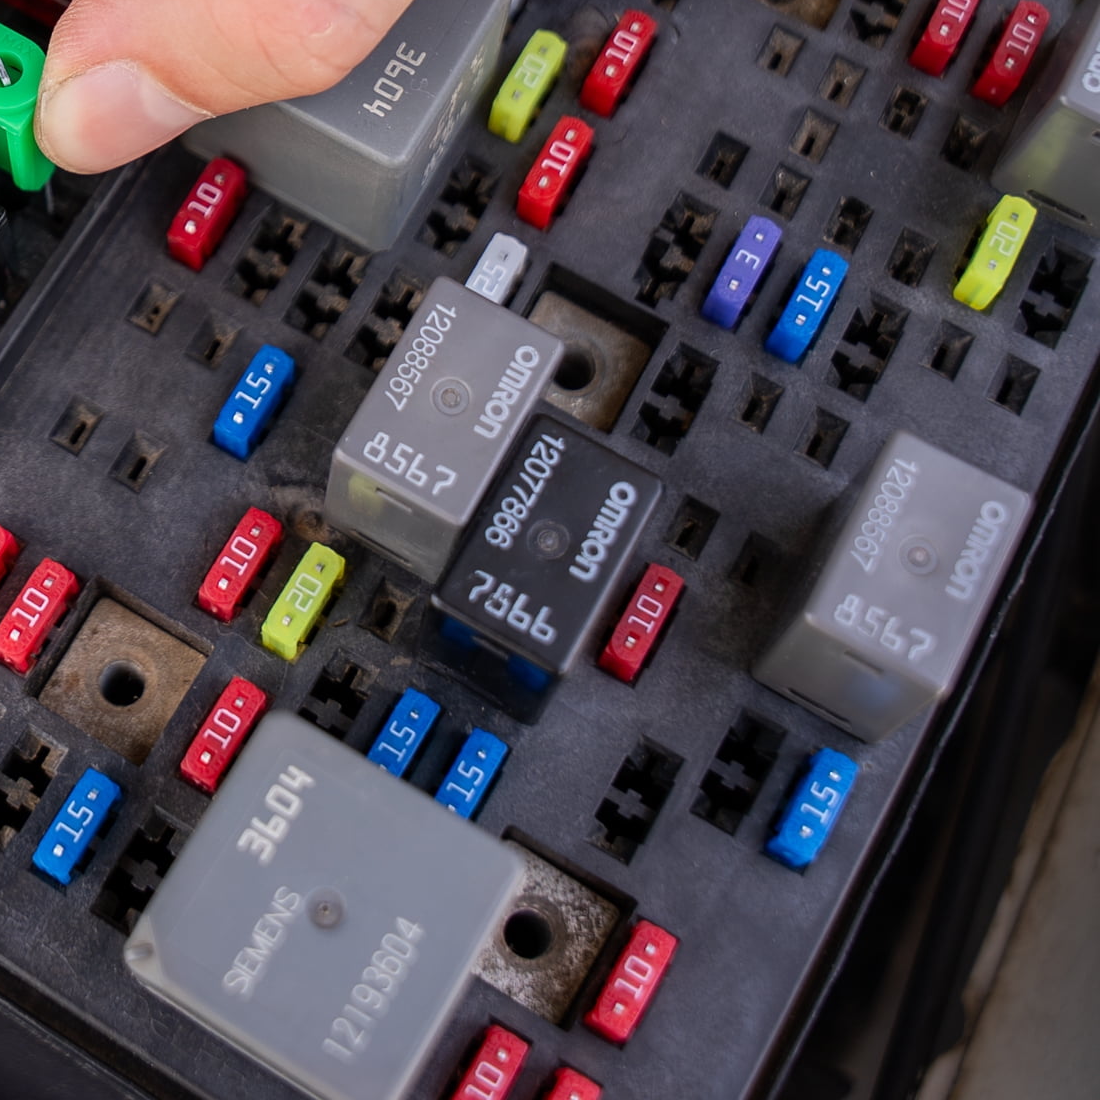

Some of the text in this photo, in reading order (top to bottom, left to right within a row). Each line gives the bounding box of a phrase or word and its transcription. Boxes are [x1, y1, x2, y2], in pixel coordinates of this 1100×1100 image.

[606, 30, 641, 66] 10
[1006, 22, 1036, 55] 10
[362, 41, 427, 118] 3604
[516, 52, 548, 89] 20
[542, 140, 577, 178] 10
[188, 183, 223, 220] 10
[735, 248, 761, 270] 3
[988, 221, 1022, 258] 20
[473, 261, 507, 296] 25
[796, 274, 832, 312] 15
[384, 303, 457, 412] 12088567
[234, 371, 272, 410] 15
[363, 431, 458, 496] 8567
[484, 433, 568, 550] 12077866
[850, 457, 922, 576] 12088567
[220, 535, 258, 576] 10
[11, 587, 49, 628] 10
[285, 573, 322, 612] 20
[627, 594, 663, 633] 10
[833, 594, 936, 660] 8567
[203, 707, 241, 750] 10
[378, 720, 417, 764] 15
[446, 760, 485, 803] 15
[801, 781, 838, 824] 15
[54, 800, 94, 843] 15
[237, 765, 316, 865] 3604
[223, 886, 302, 996] SIEMENS
[324, 917, 422, 1058] 12193604
[614, 955, 652, 999] 10
[465, 1061, 503, 1100] 10
